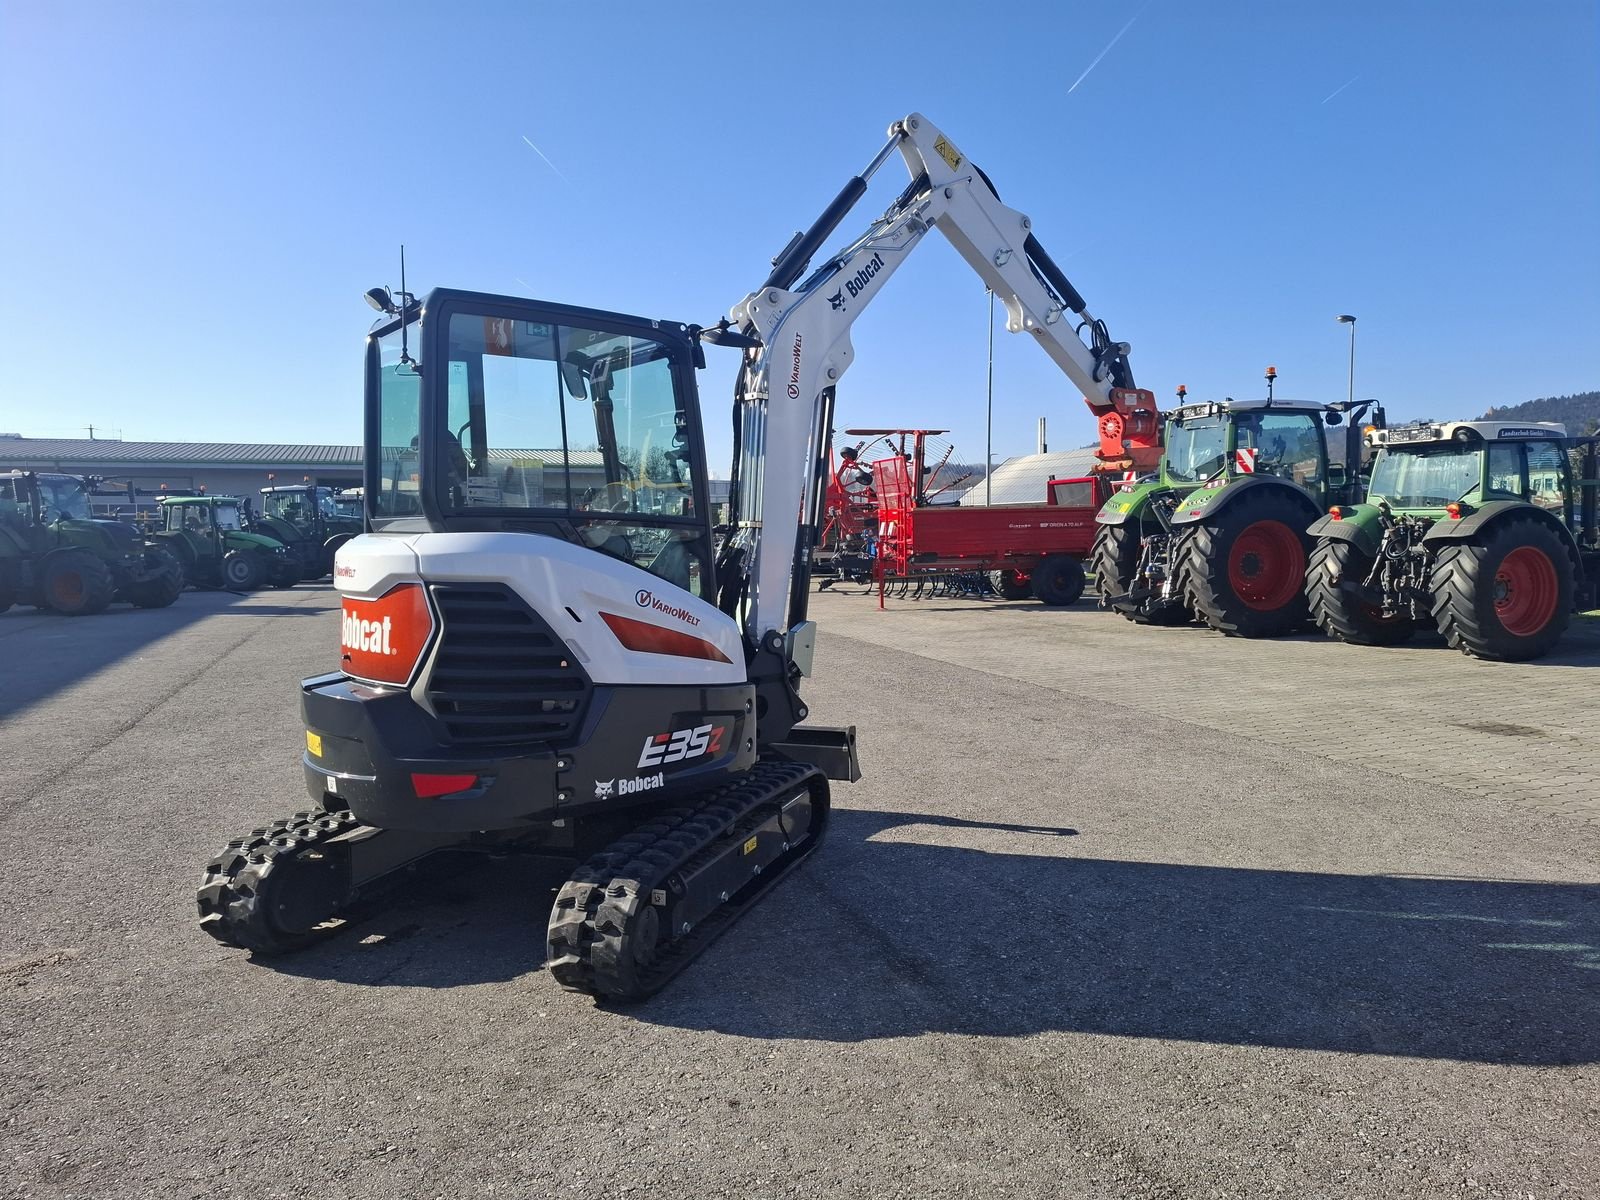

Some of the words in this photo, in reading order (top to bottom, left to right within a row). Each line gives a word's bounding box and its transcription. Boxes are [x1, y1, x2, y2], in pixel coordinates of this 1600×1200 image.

[845, 252, 884, 298] Bobcat
[342, 608, 392, 655] Bobcat
[618, 772, 665, 796] Bobcat
